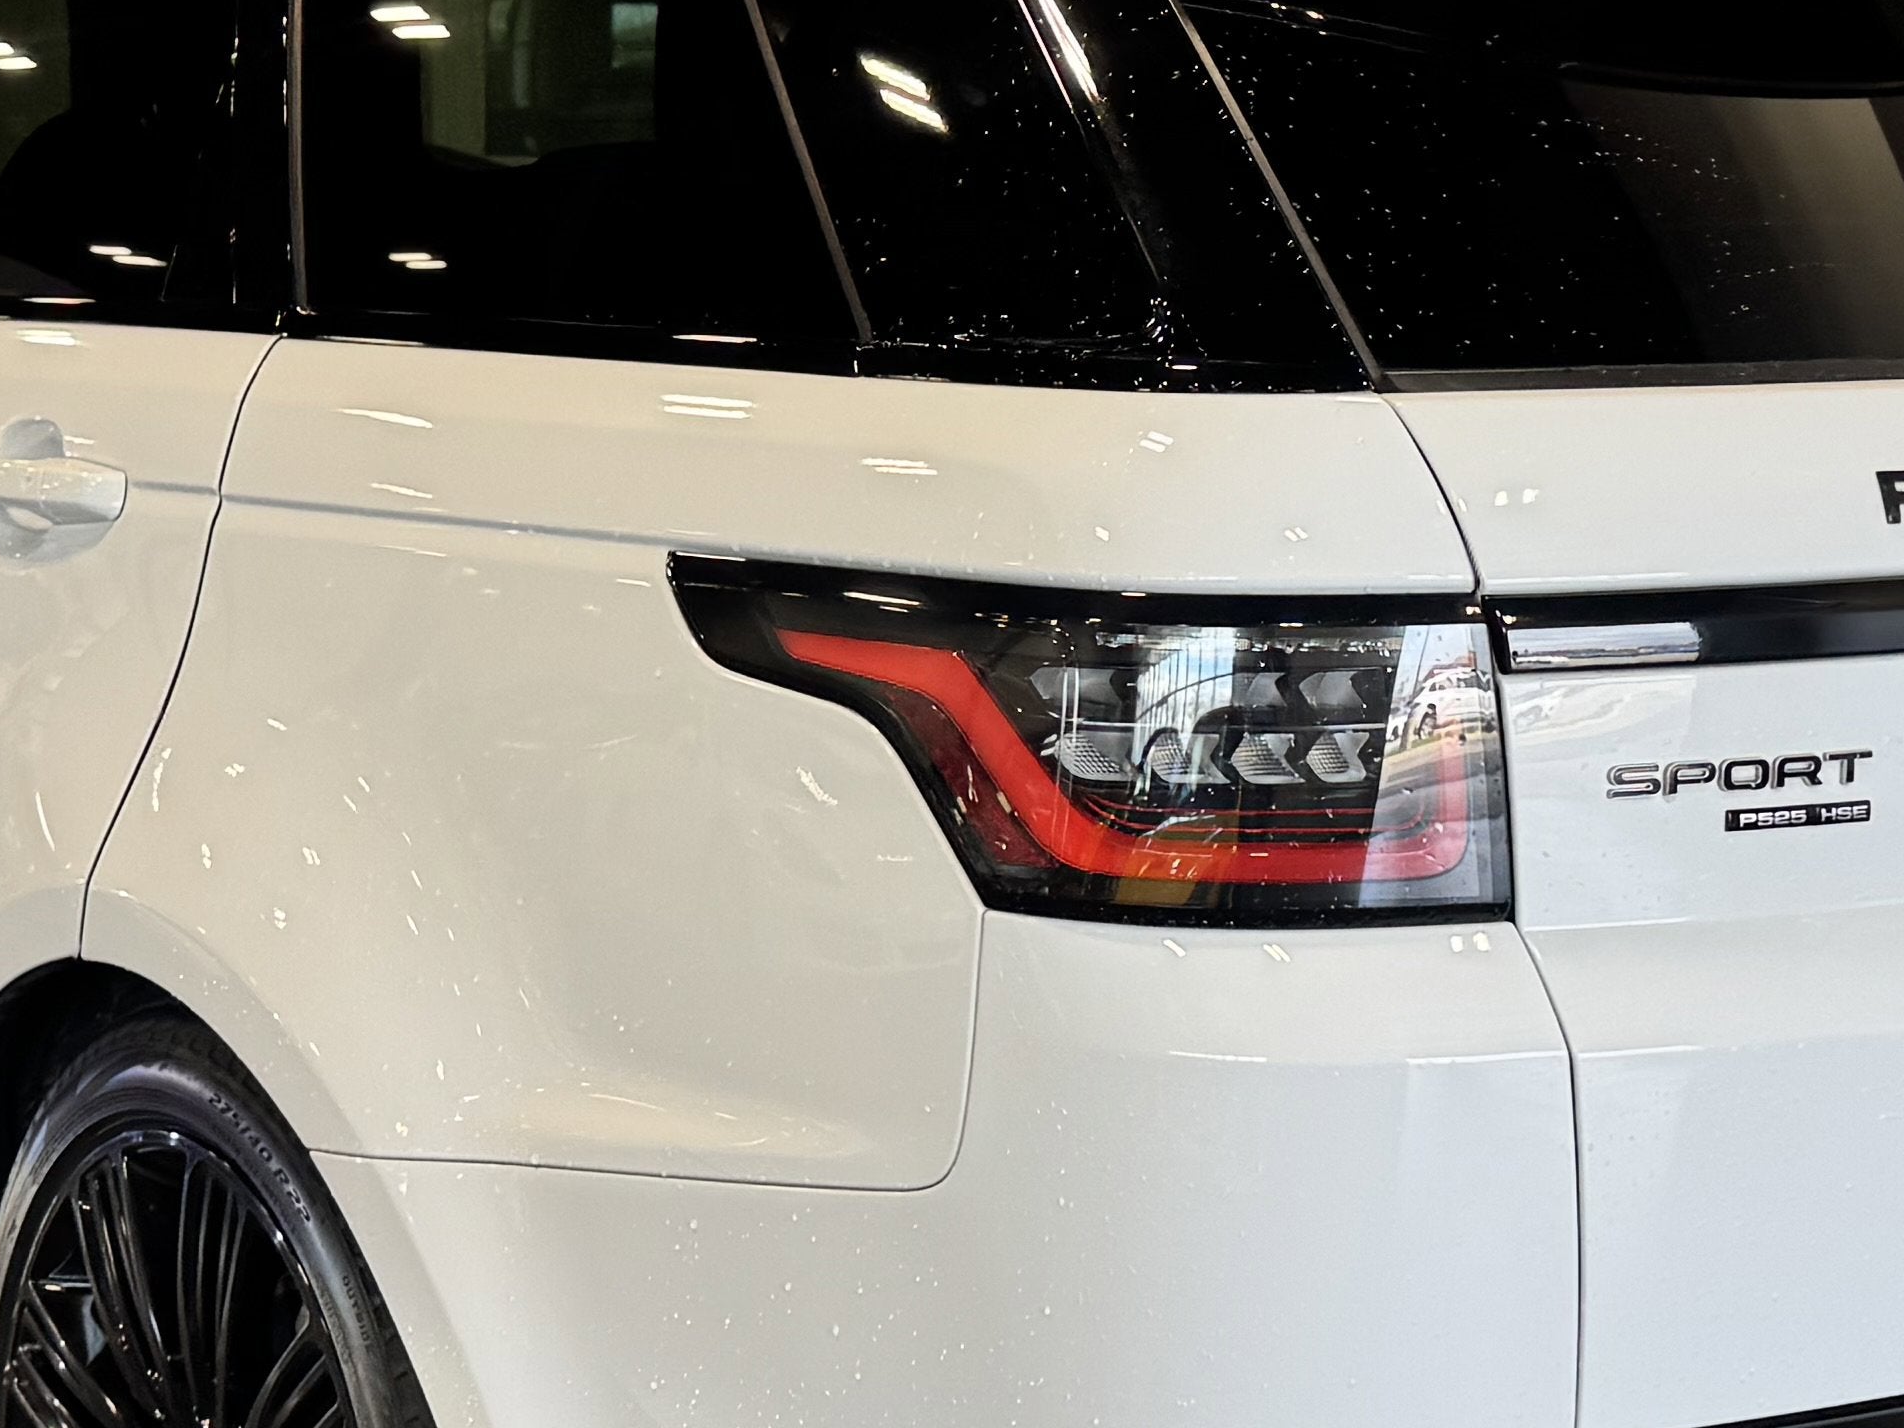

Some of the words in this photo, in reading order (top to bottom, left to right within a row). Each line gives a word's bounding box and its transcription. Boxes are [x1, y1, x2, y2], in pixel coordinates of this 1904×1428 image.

[1606, 749, 1873, 800] SPORT
[1739, 809, 1807, 828] P525
[1820, 804, 1869, 822] HSE
